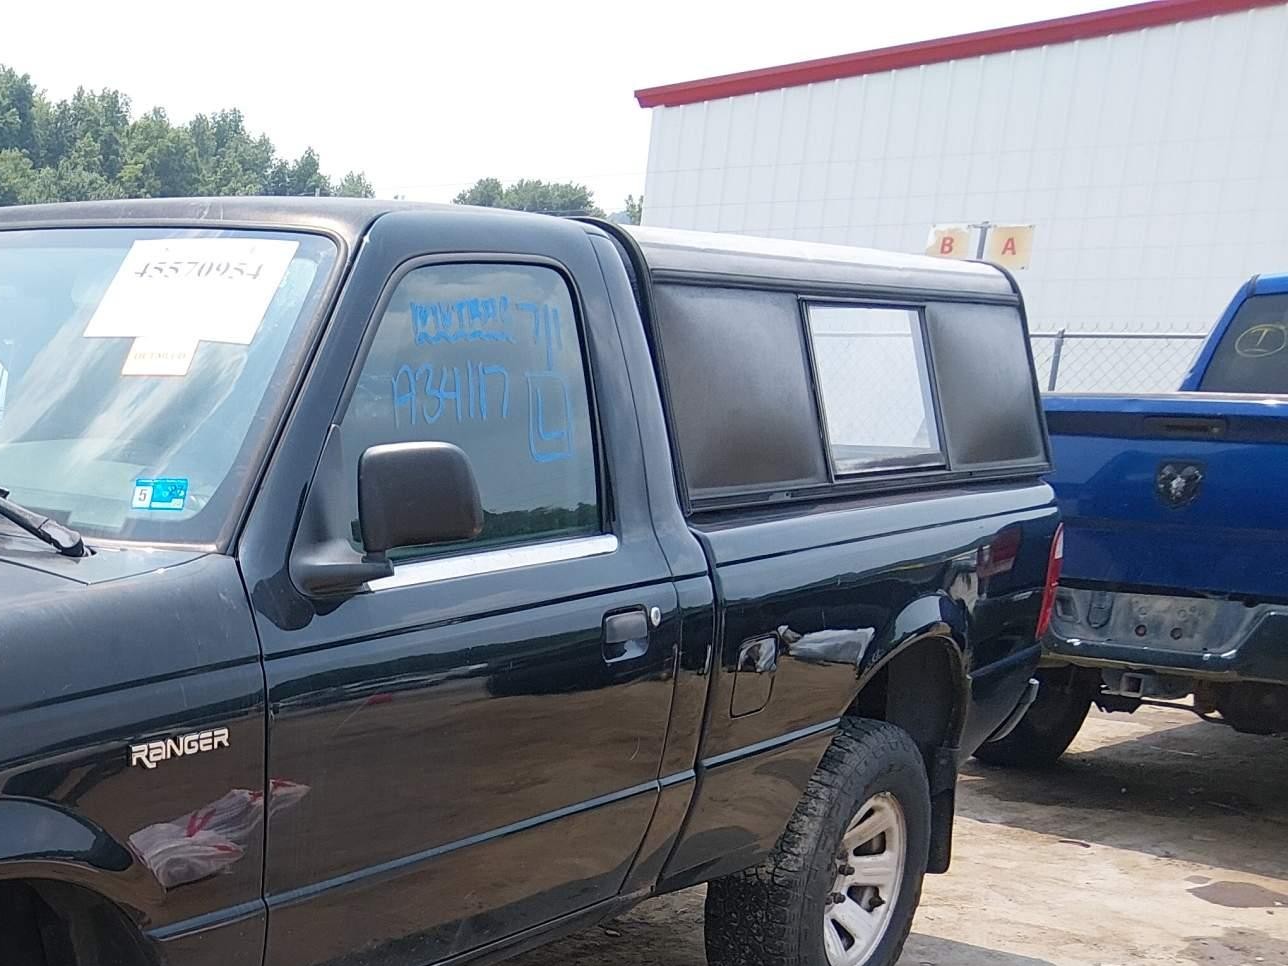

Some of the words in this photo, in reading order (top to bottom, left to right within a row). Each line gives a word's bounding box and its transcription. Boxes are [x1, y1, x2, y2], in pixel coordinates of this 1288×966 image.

[939, 236, 955, 255] B
[1001, 236, 1017, 256] A
[134, 260, 265, 280] 45570954
[138, 488, 148, 502] 5
[131, 727, 230, 769] RANGER
